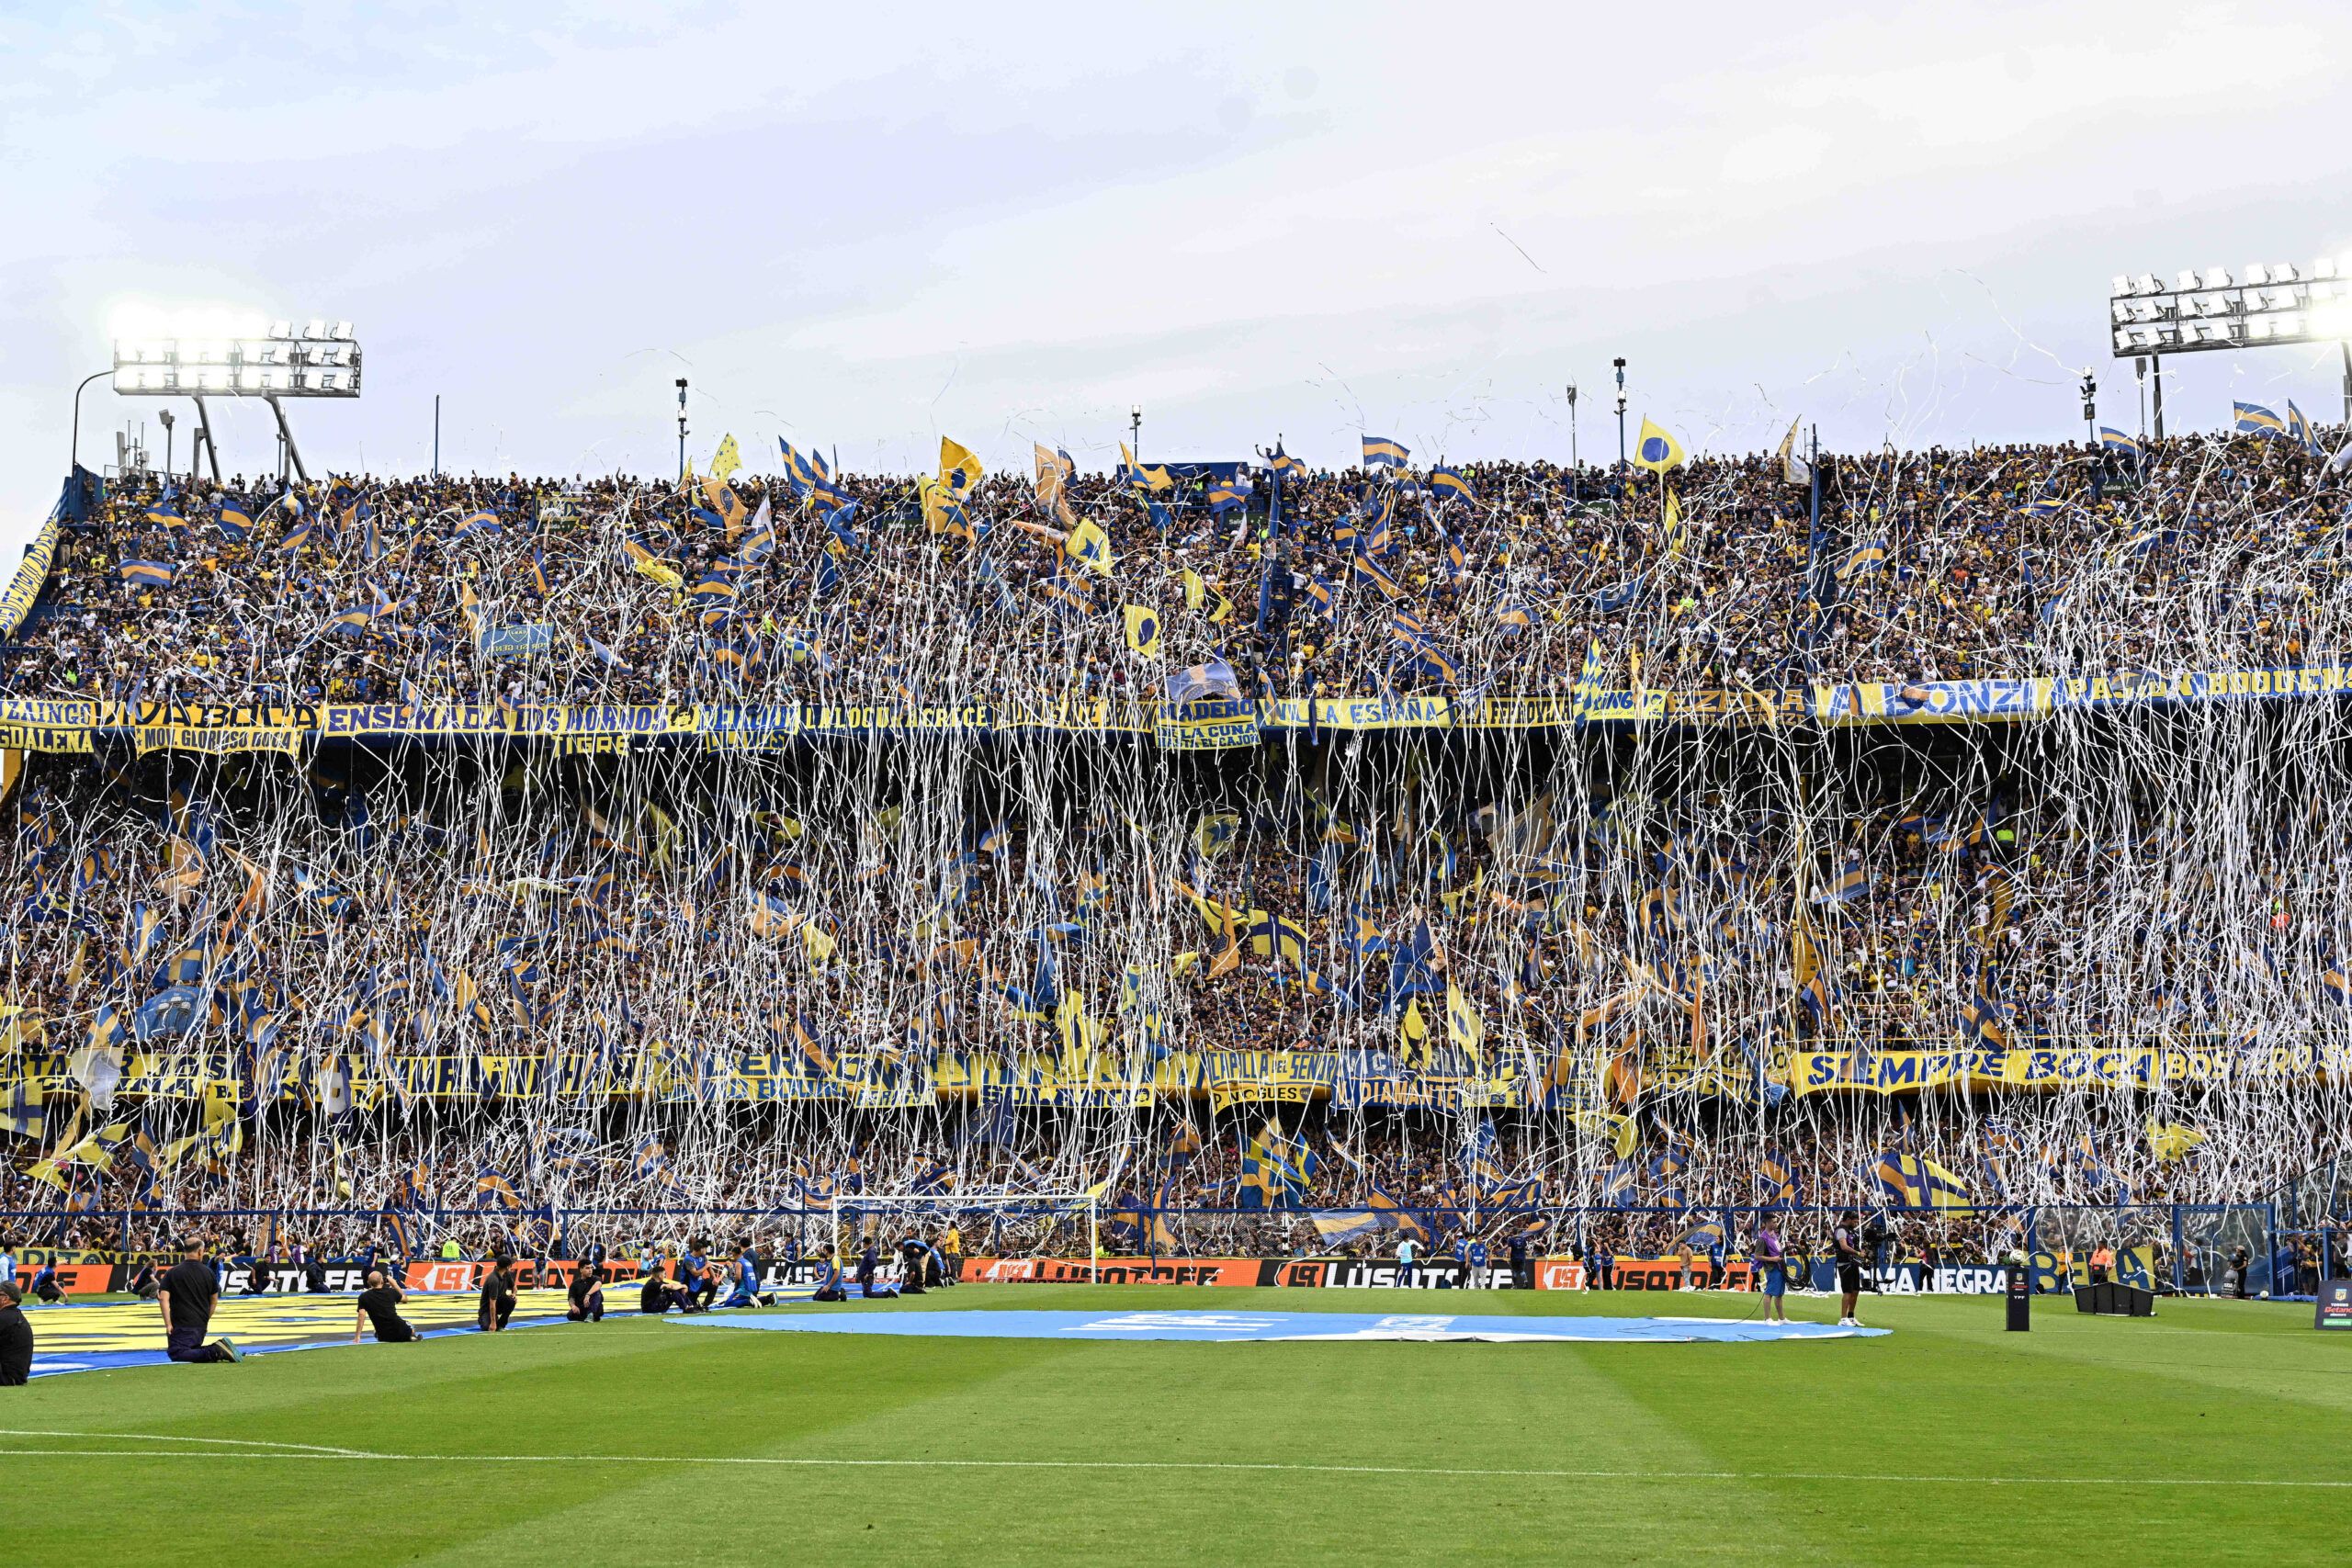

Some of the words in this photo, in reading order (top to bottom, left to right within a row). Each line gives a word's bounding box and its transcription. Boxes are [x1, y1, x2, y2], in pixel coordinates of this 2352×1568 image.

[0, 701, 90, 725] ZAINGO
[1212, 1052, 1270, 1080] CAPILLA
[2024, 1052, 2154, 1082] BOCA
